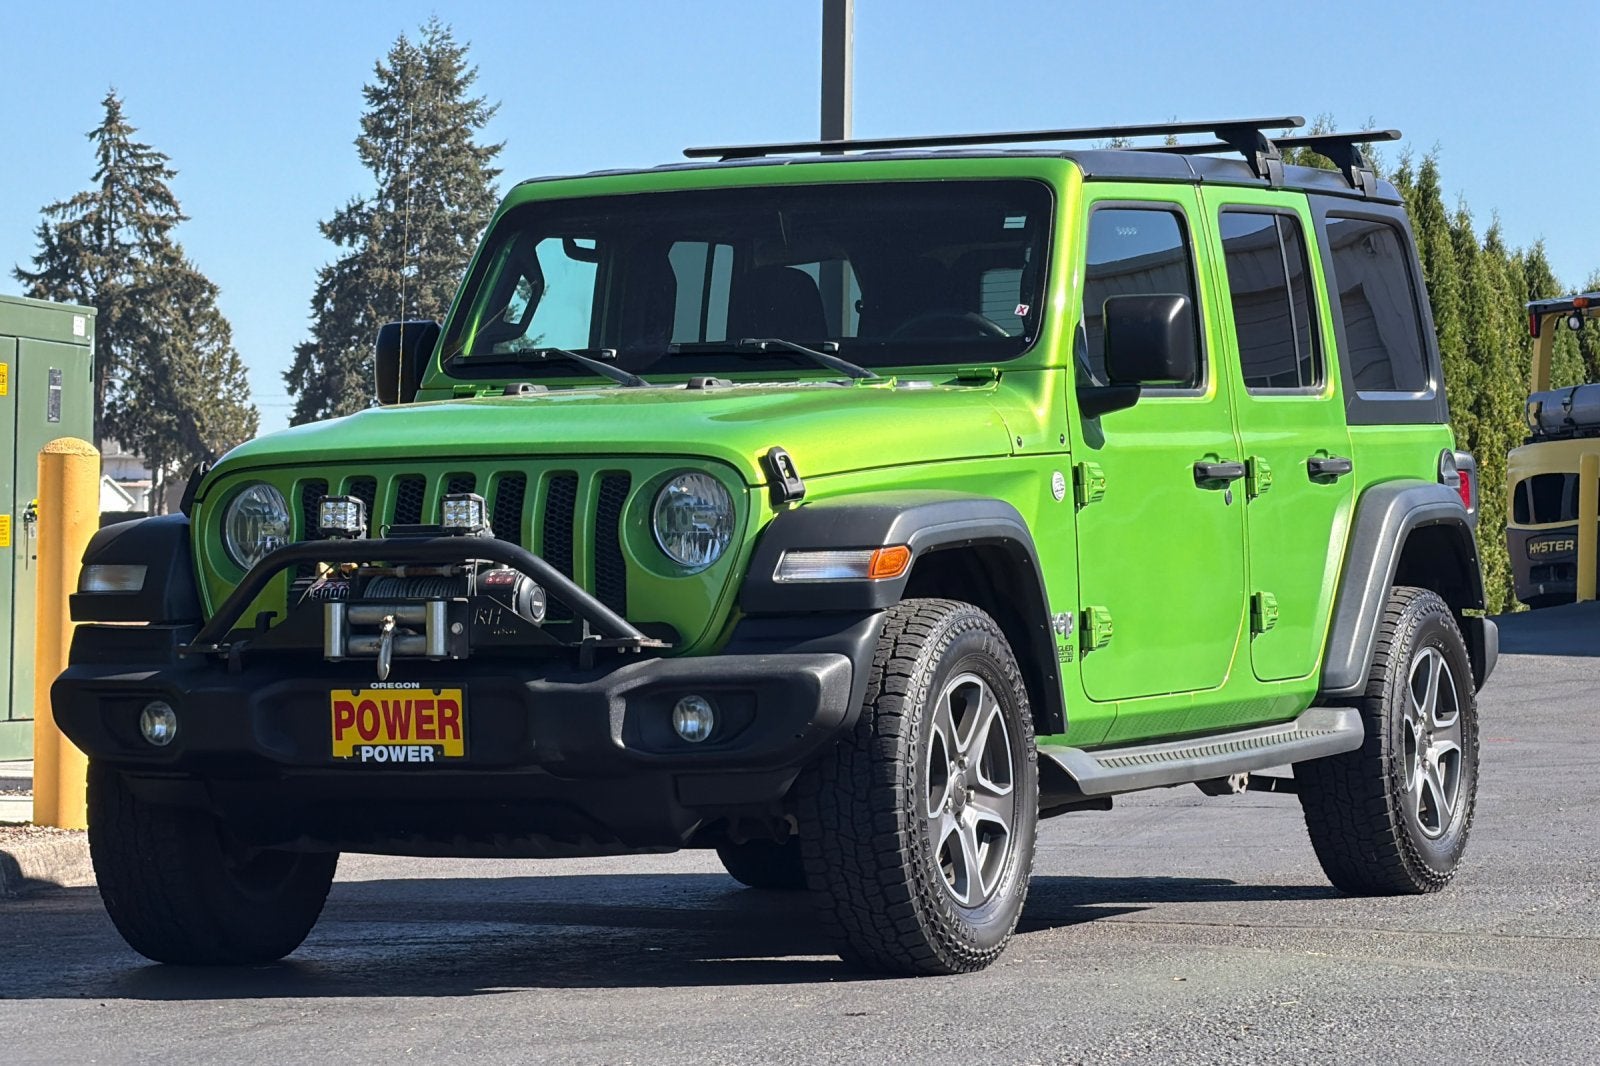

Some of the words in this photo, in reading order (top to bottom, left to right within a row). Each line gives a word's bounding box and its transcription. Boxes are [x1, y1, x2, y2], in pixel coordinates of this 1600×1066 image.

[1529, 540, 1574, 554] HYSTER
[333, 699, 461, 741] POWER
[361, 745, 435, 762] POWER
